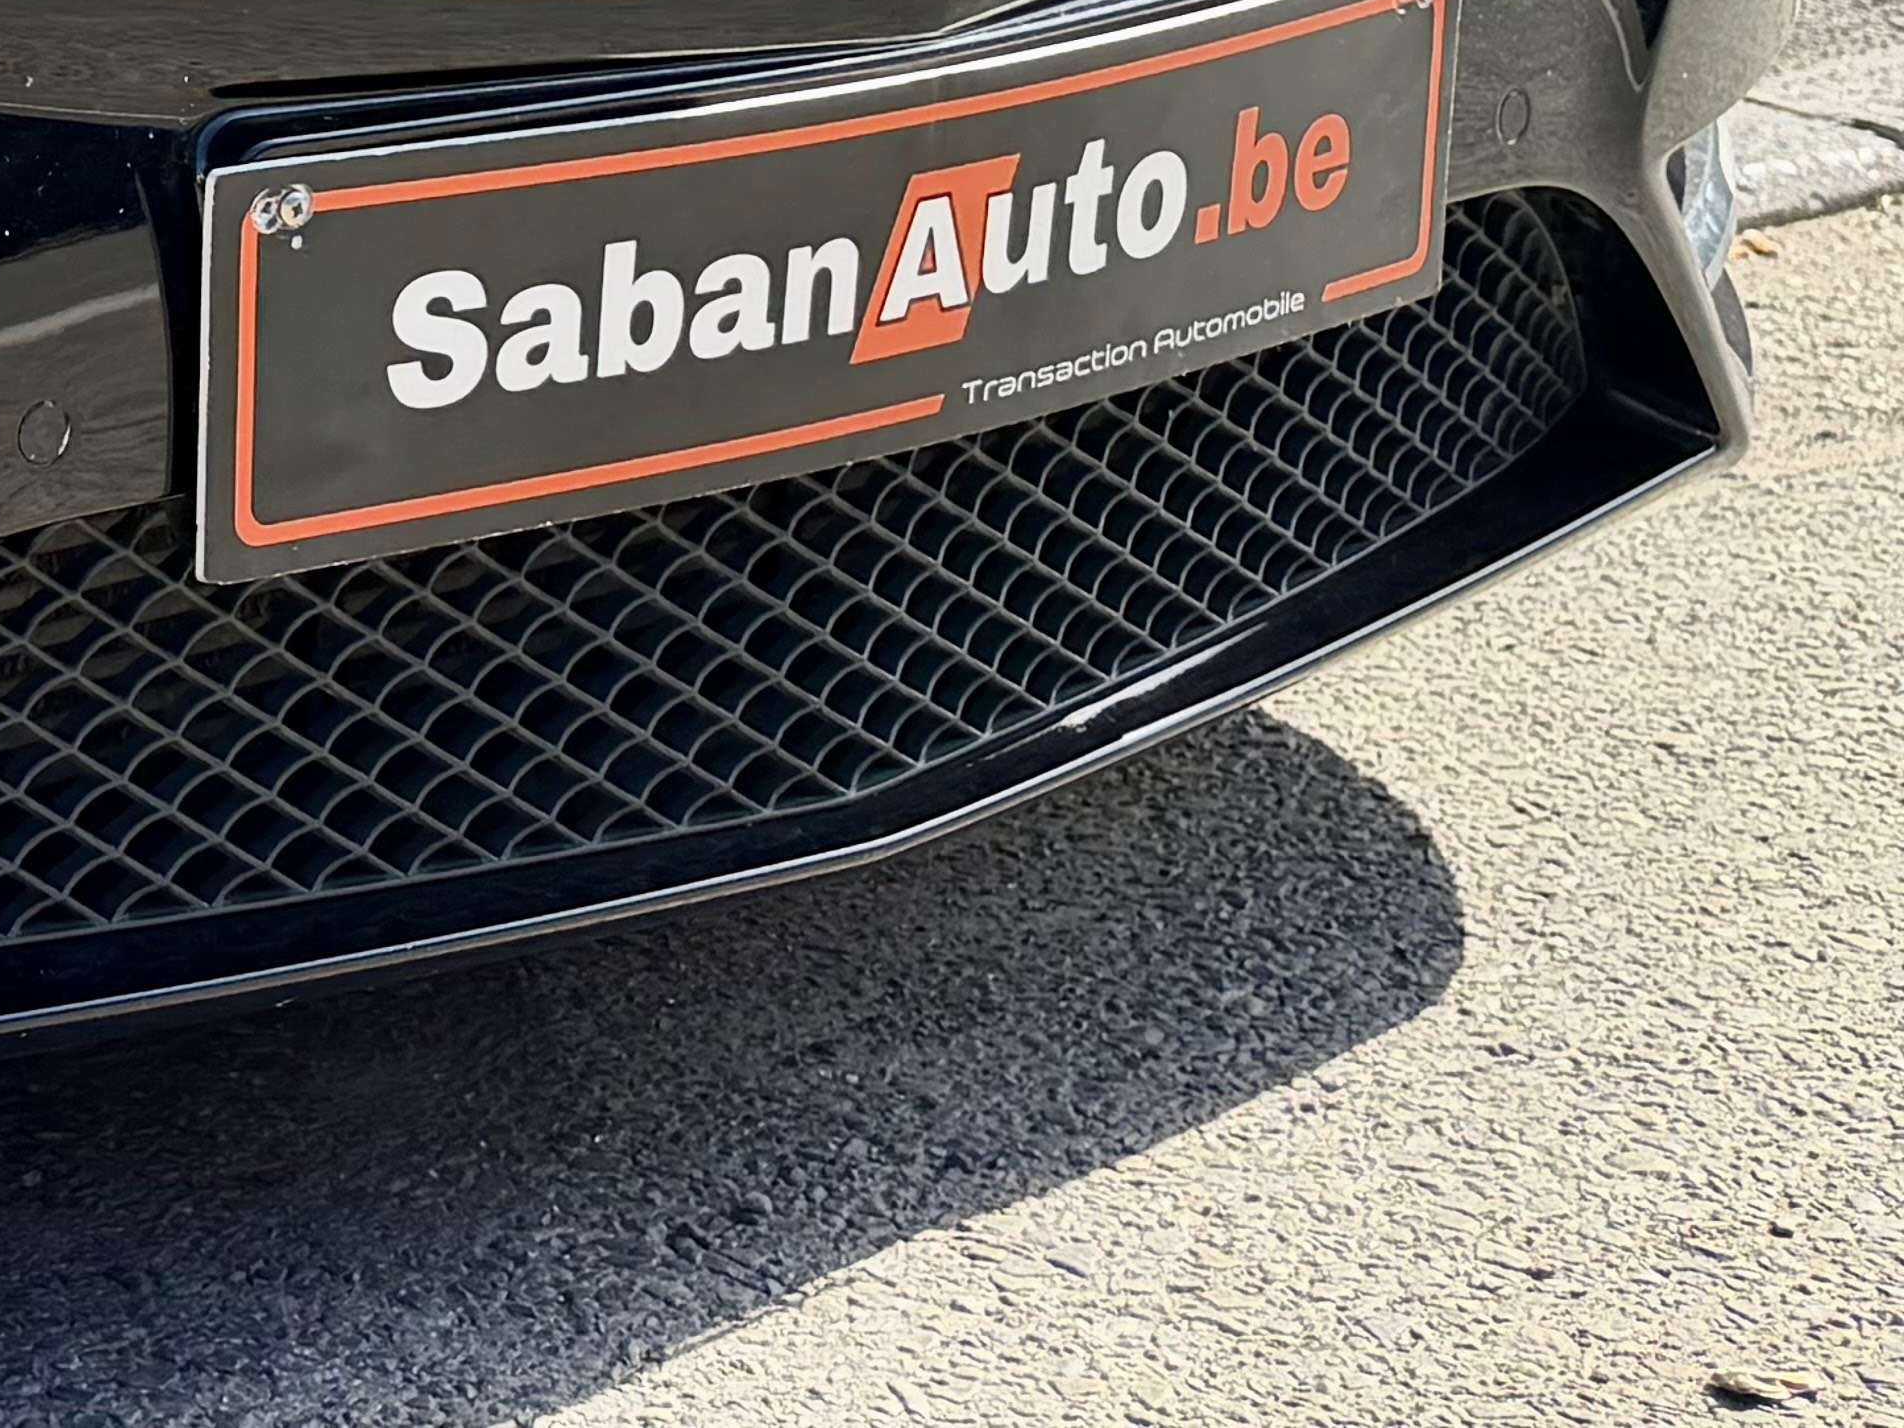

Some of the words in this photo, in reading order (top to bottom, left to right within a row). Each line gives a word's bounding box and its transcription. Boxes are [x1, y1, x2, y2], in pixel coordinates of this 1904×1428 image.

[388, 105, 1351, 412] SabanAuto.be
[961, 340, 1148, 405] Transaction
[1153, 290, 1306, 355] Automobile
